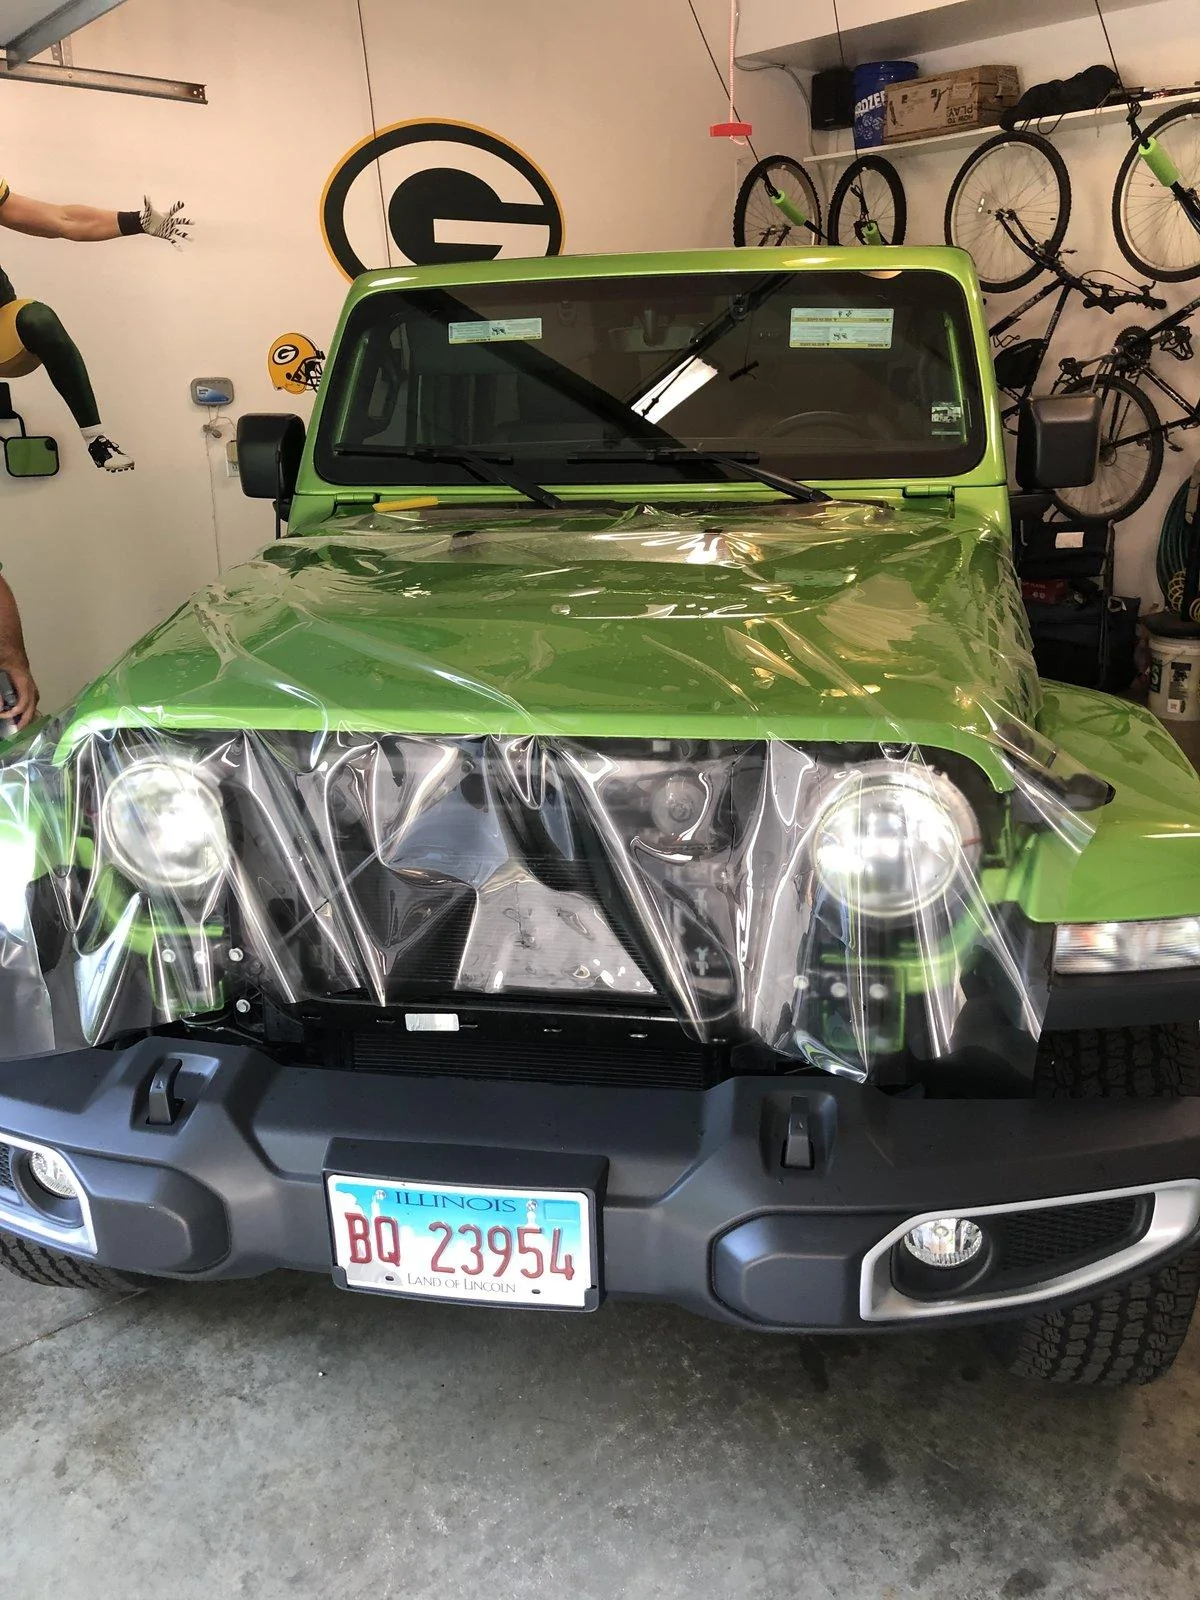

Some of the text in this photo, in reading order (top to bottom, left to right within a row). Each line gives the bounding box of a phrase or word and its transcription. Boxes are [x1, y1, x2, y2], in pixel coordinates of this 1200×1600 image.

[395, 1190, 517, 1213] ILLINOIS
[344, 1212, 575, 1281] BQ 23954
[407, 1273, 516, 1294] LAND OF LINCOLN
